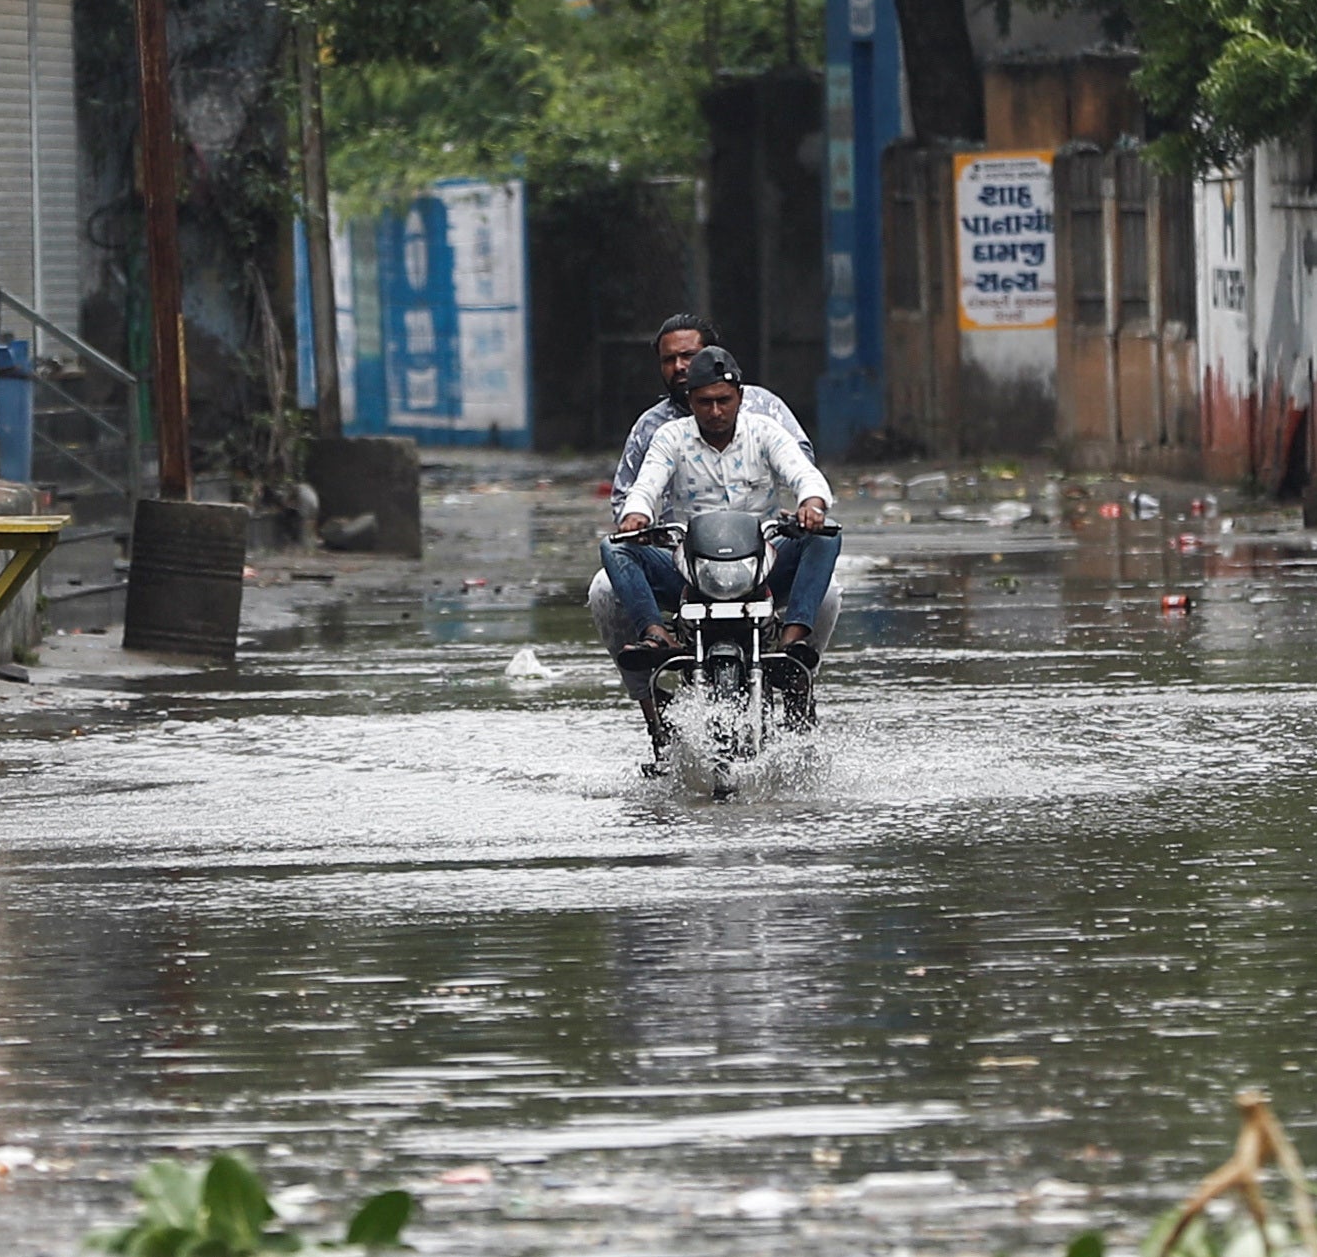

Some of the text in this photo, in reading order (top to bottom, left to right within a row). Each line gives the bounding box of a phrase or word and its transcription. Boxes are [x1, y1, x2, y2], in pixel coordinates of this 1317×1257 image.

[977, 184, 1033, 209] શાહ
[973, 242, 1046, 266] દામજી
[975, 271, 1039, 295] સન્સ
